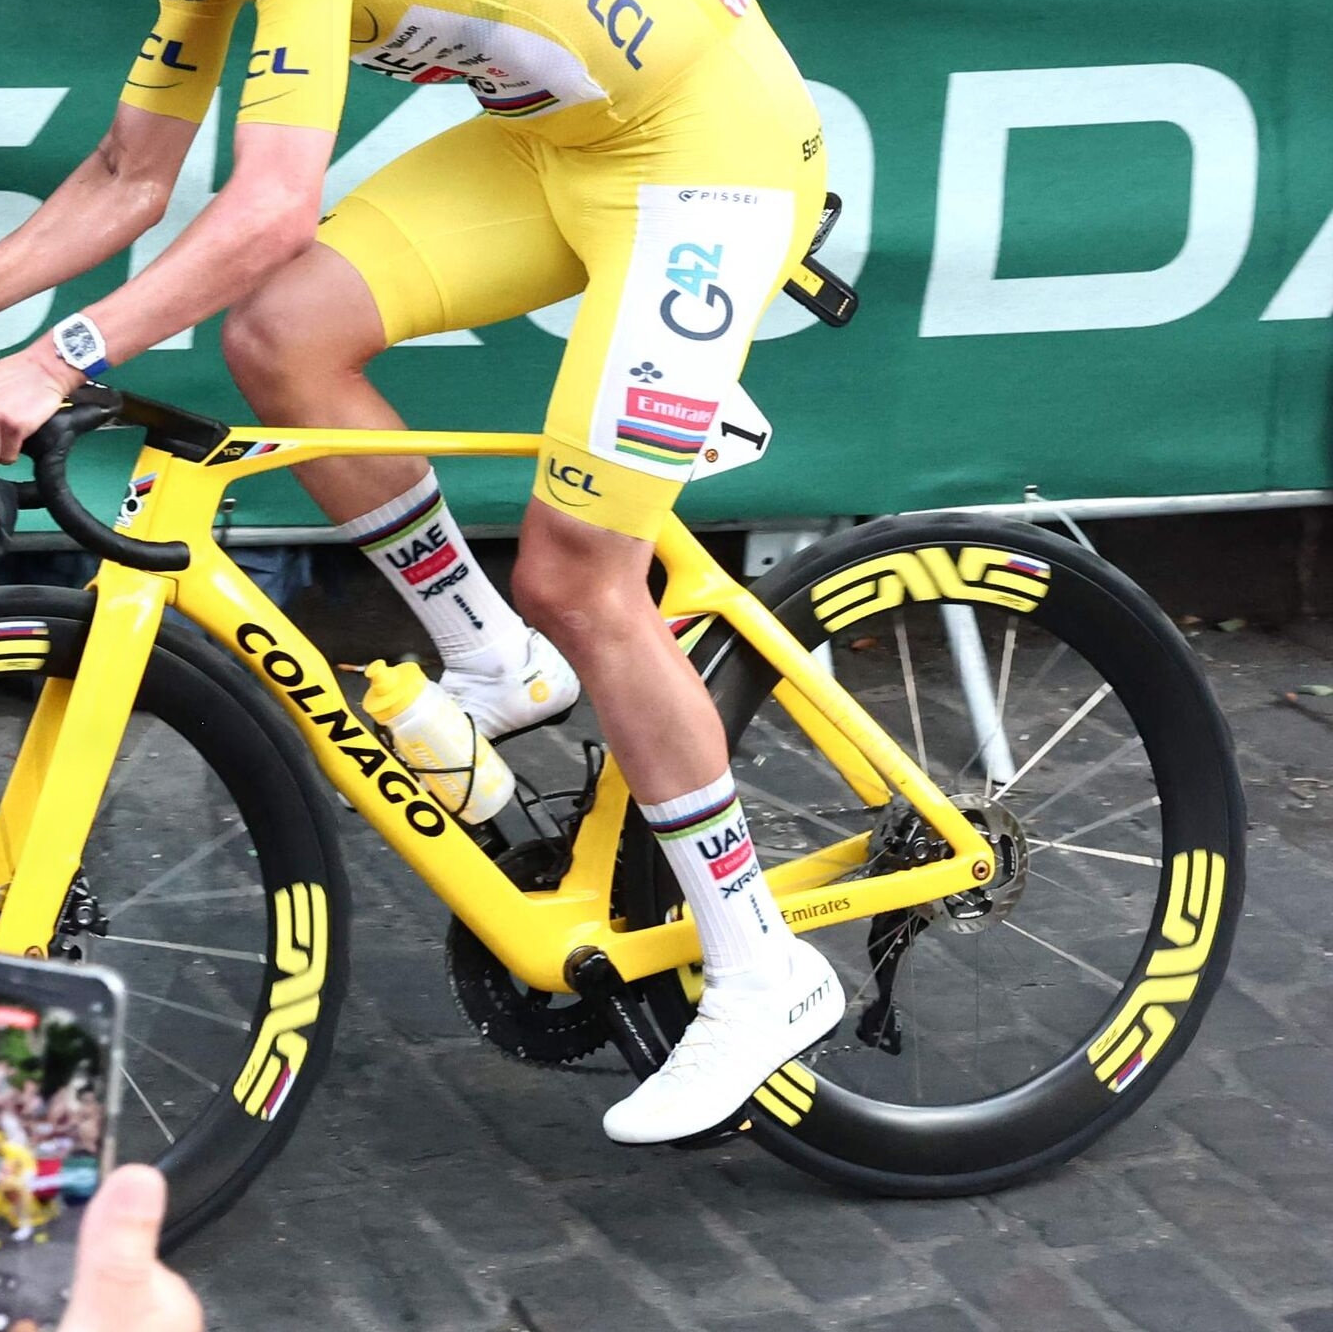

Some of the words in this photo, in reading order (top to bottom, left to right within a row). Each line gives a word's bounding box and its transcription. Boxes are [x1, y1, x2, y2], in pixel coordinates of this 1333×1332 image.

[139, 32, 198, 73] CL
[246, 46, 310, 80] CL
[700, 191, 758, 205] PISSEI
[659, 242, 734, 342] G42
[721, 420, 768, 451] 1
[549, 457, 603, 498] LCL
[385, 523, 448, 568] UAE
[236, 622, 446, 838] COLNAGO
[782, 896, 851, 925] Emirates
